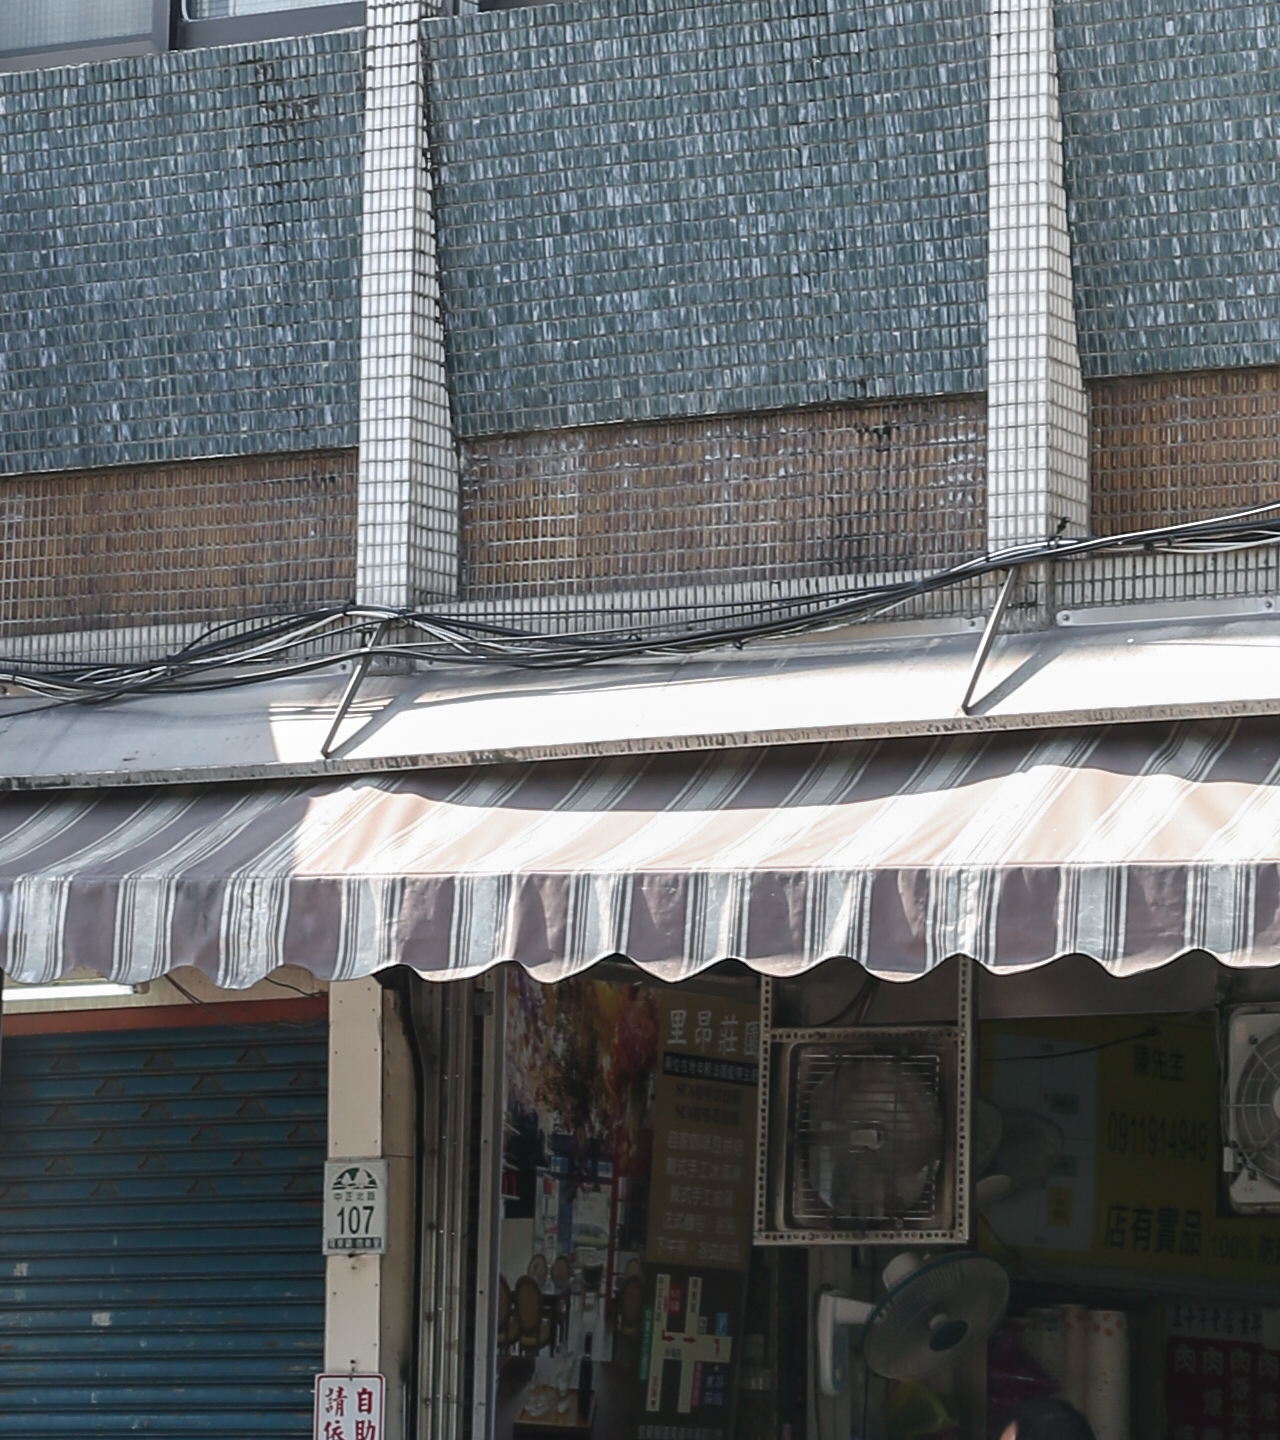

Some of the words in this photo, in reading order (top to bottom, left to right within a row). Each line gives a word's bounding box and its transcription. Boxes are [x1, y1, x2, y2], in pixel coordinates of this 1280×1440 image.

[333, 1191, 376, 1202] 中正北路
[337, 1205, 375, 1235] 107
